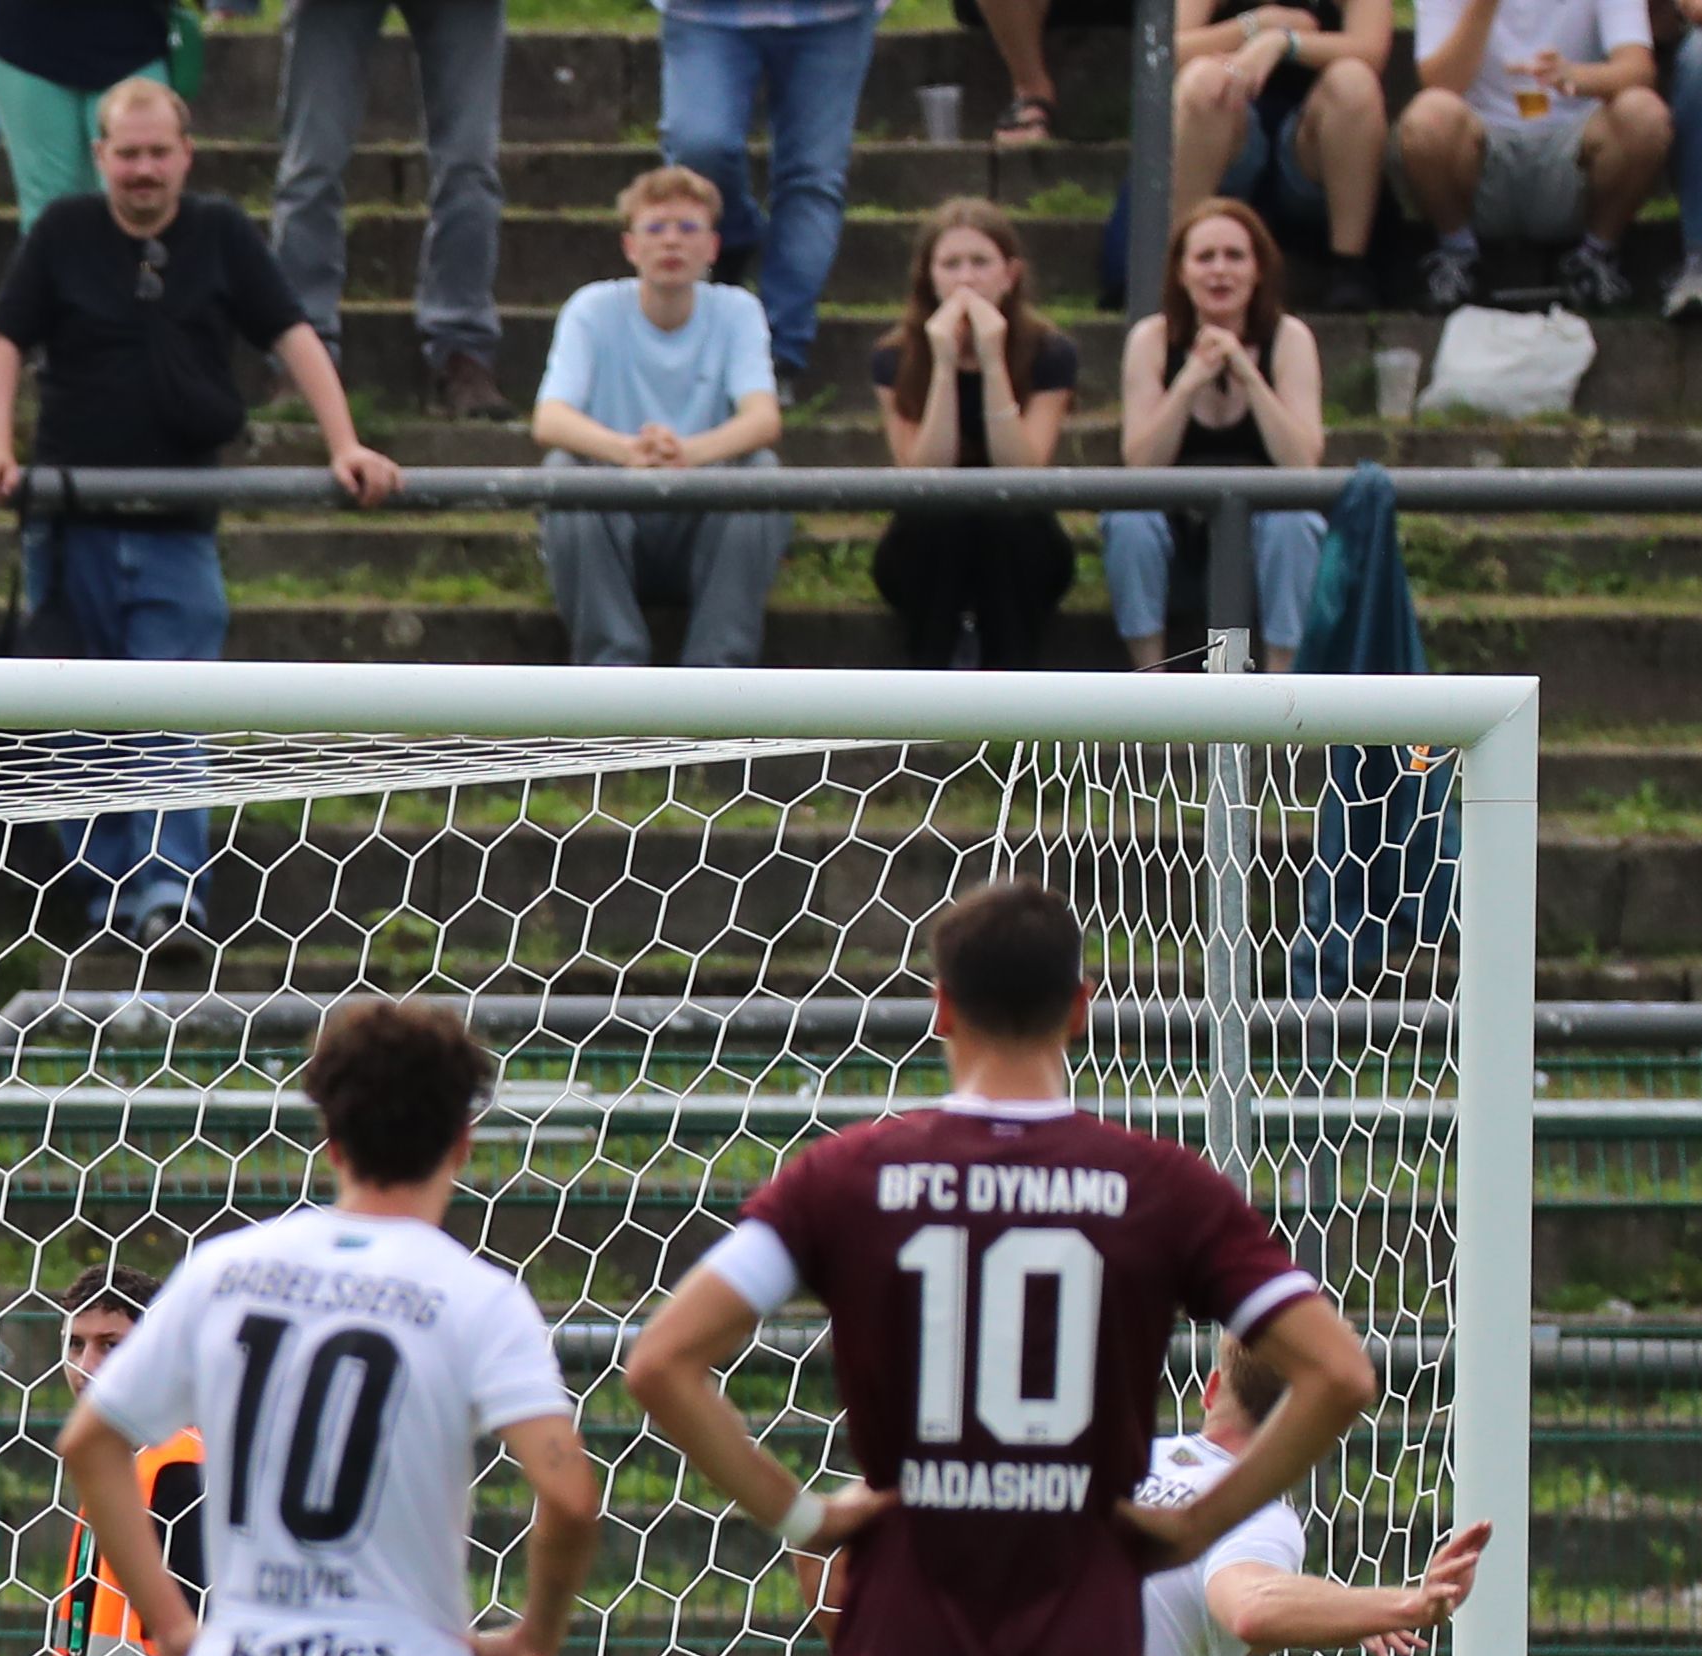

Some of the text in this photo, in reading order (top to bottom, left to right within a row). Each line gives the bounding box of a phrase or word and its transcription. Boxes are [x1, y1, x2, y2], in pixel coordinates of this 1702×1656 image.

[878, 1163, 1130, 1218] BFC DYNAMO
[897, 1224, 1104, 1446] 10
[228, 1312, 405, 1543] 10
[900, 1457, 1093, 1513] DADASHOV
